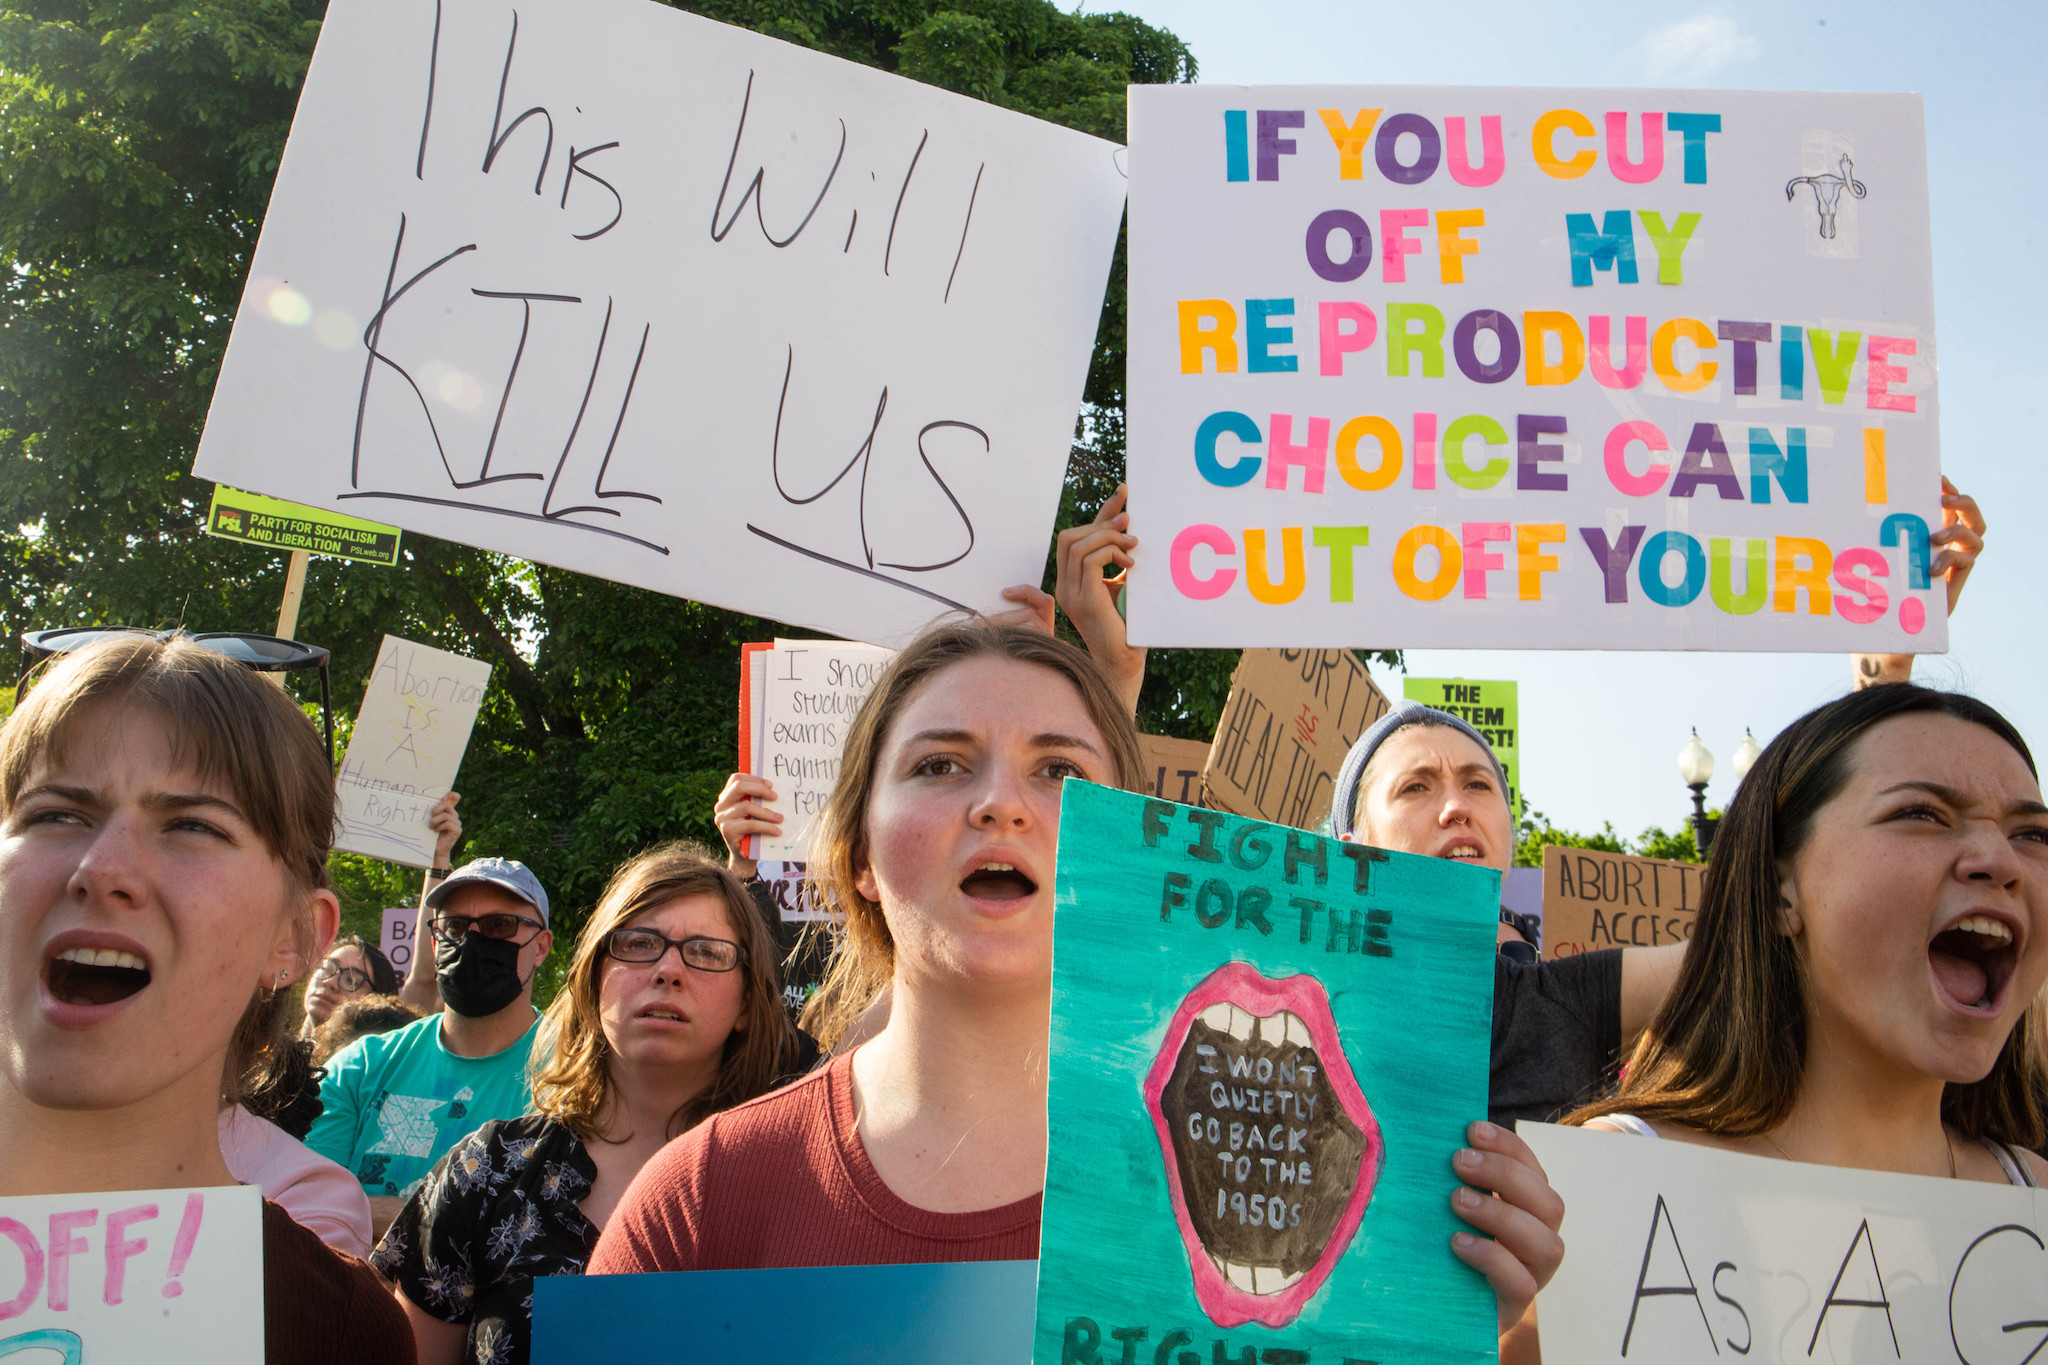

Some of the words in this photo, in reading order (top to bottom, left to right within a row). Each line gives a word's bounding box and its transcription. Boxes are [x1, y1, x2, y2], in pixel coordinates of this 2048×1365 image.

[1225, 109, 1305, 182] IF
[1317, 108, 1505, 187] YOU
[1531, 109, 1722, 185] CUT
[711, 68, 984, 303] Will
[1305, 208, 1485, 284] OFF
[1565, 209, 1703, 287] MY
[1177, 297, 1918, 413] REPRODUCTIVE
[1194, 411, 1569, 494] CHOICE
[1603, 420, 1809, 504] CAN
[1863, 428, 1888, 504] I
[217, 516, 243, 533] PSL
[247, 527, 273, 541] AND
[275, 531, 342, 553] LIBERATION
[250, 513, 289, 531] PARTY
[290, 521, 312, 534] FOR
[314, 524, 378, 545] SOCIALISM
[350, 545, 390, 561] PSLweb.org
[1169, 524, 1370, 605] CUT
[1392, 522, 1567, 602] OFF
[370, 645, 482, 705] Abortion
[778, 650, 808, 681] I
[1442, 684, 1481, 704] THE
[385, 732, 418, 769] A
[340, 758, 416, 797] Human
[1142, 800, 1391, 896] FIGHT
[1160, 872, 1273, 937] FOR
[1289, 896, 1393, 957] THE
[1197, 1044, 1218, 1074] I
[1210, 1081, 1318, 1121] QUIETLY
[1188, 1112, 1221, 1146] GO
[1229, 1121, 1308, 1153] BACK
[1217, 1152, 1251, 1183] TO
[1260, 1157, 1313, 1186] THE
[1807, 1217, 1901, 1359] A
